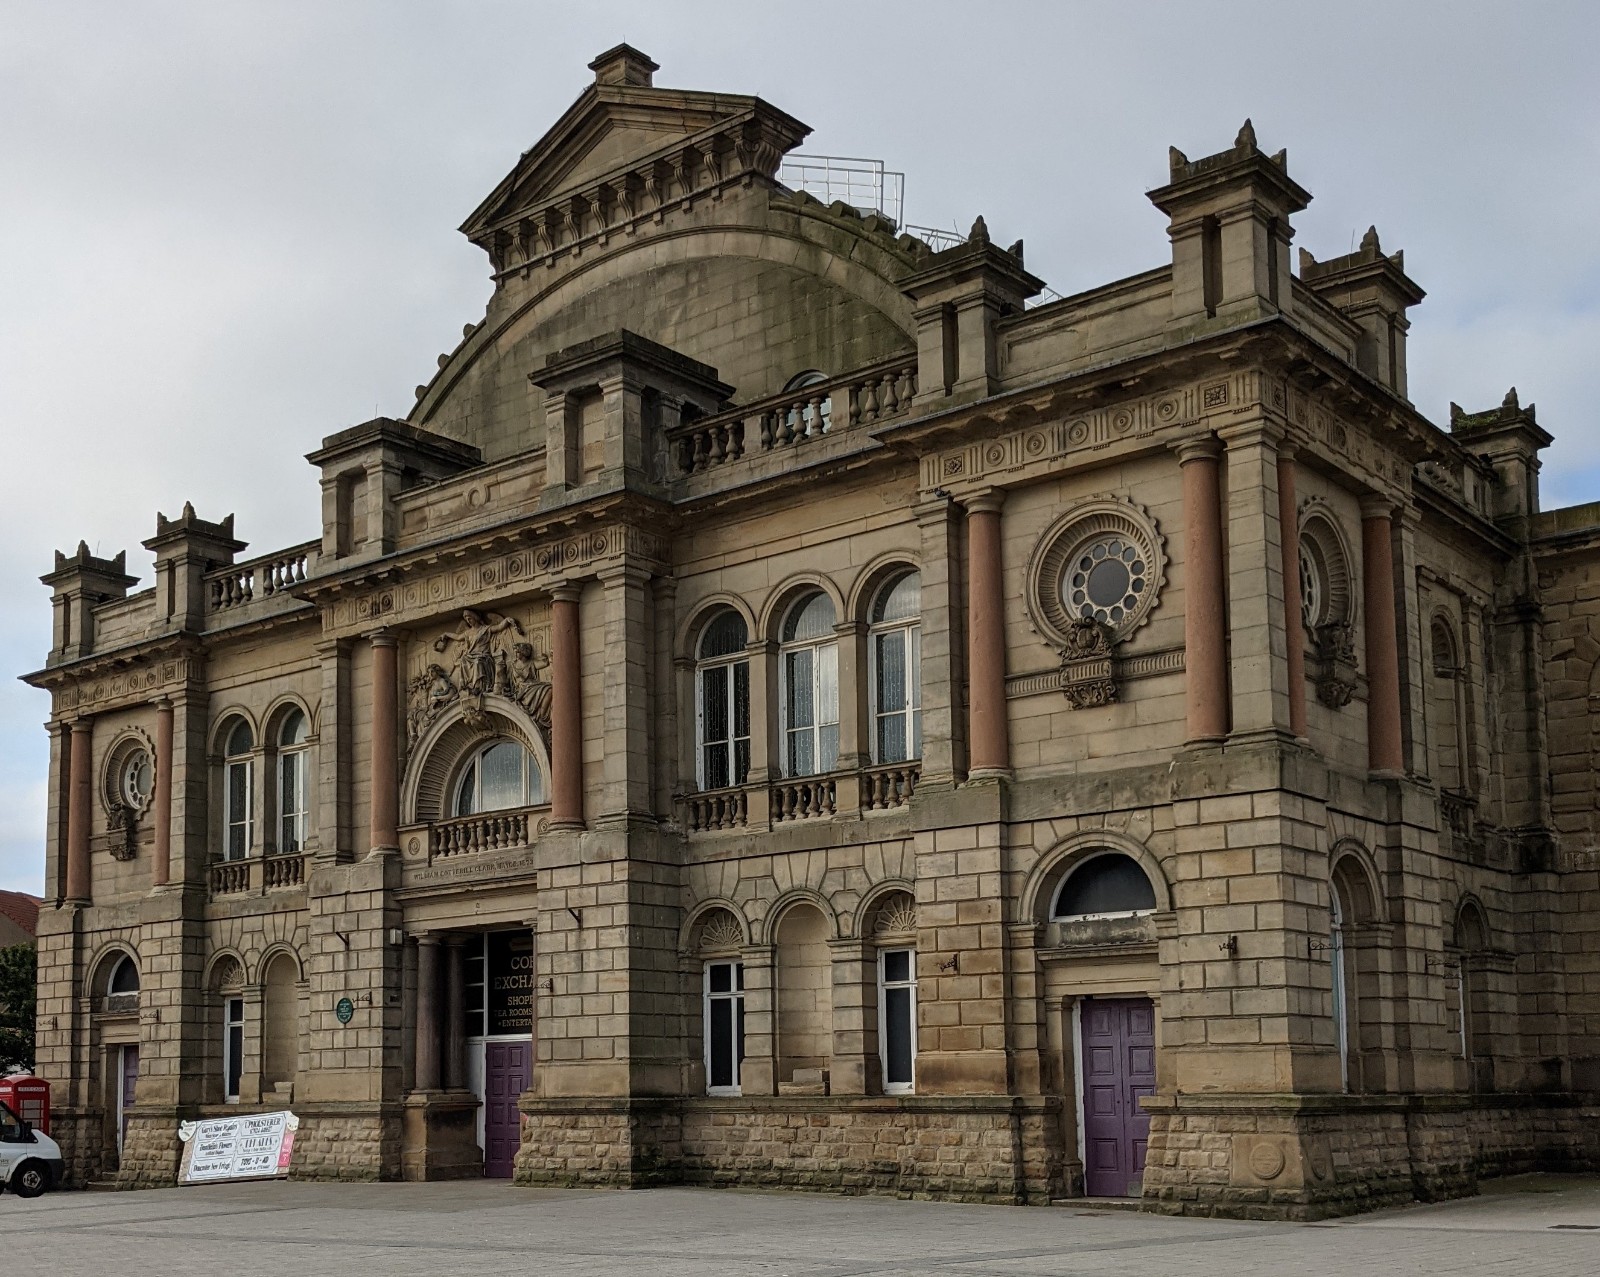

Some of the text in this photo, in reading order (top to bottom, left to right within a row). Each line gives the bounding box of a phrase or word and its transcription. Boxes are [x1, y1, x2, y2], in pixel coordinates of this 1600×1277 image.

[413, 871, 439, 880] WILLIAM
[440, 864, 473, 877] COTTERILL
[509, 1007, 533, 1017] ROOMS
